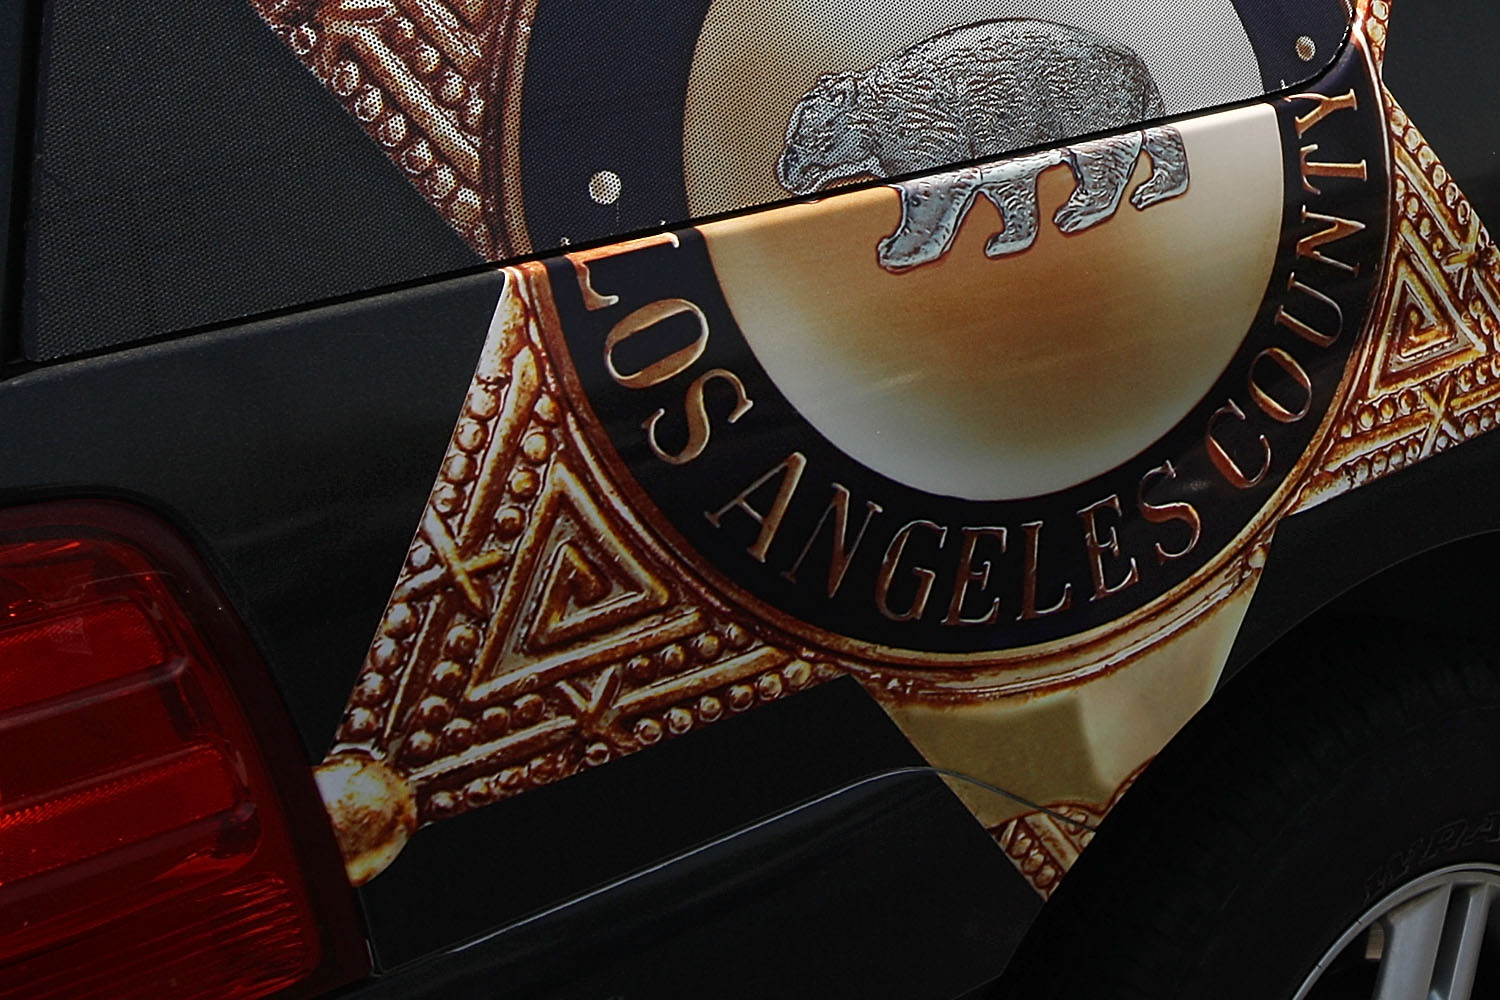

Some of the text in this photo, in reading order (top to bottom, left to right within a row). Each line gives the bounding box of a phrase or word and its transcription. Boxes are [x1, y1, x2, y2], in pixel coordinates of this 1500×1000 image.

[564, 88, 1368, 626] LOS ANGELES COUNTY
